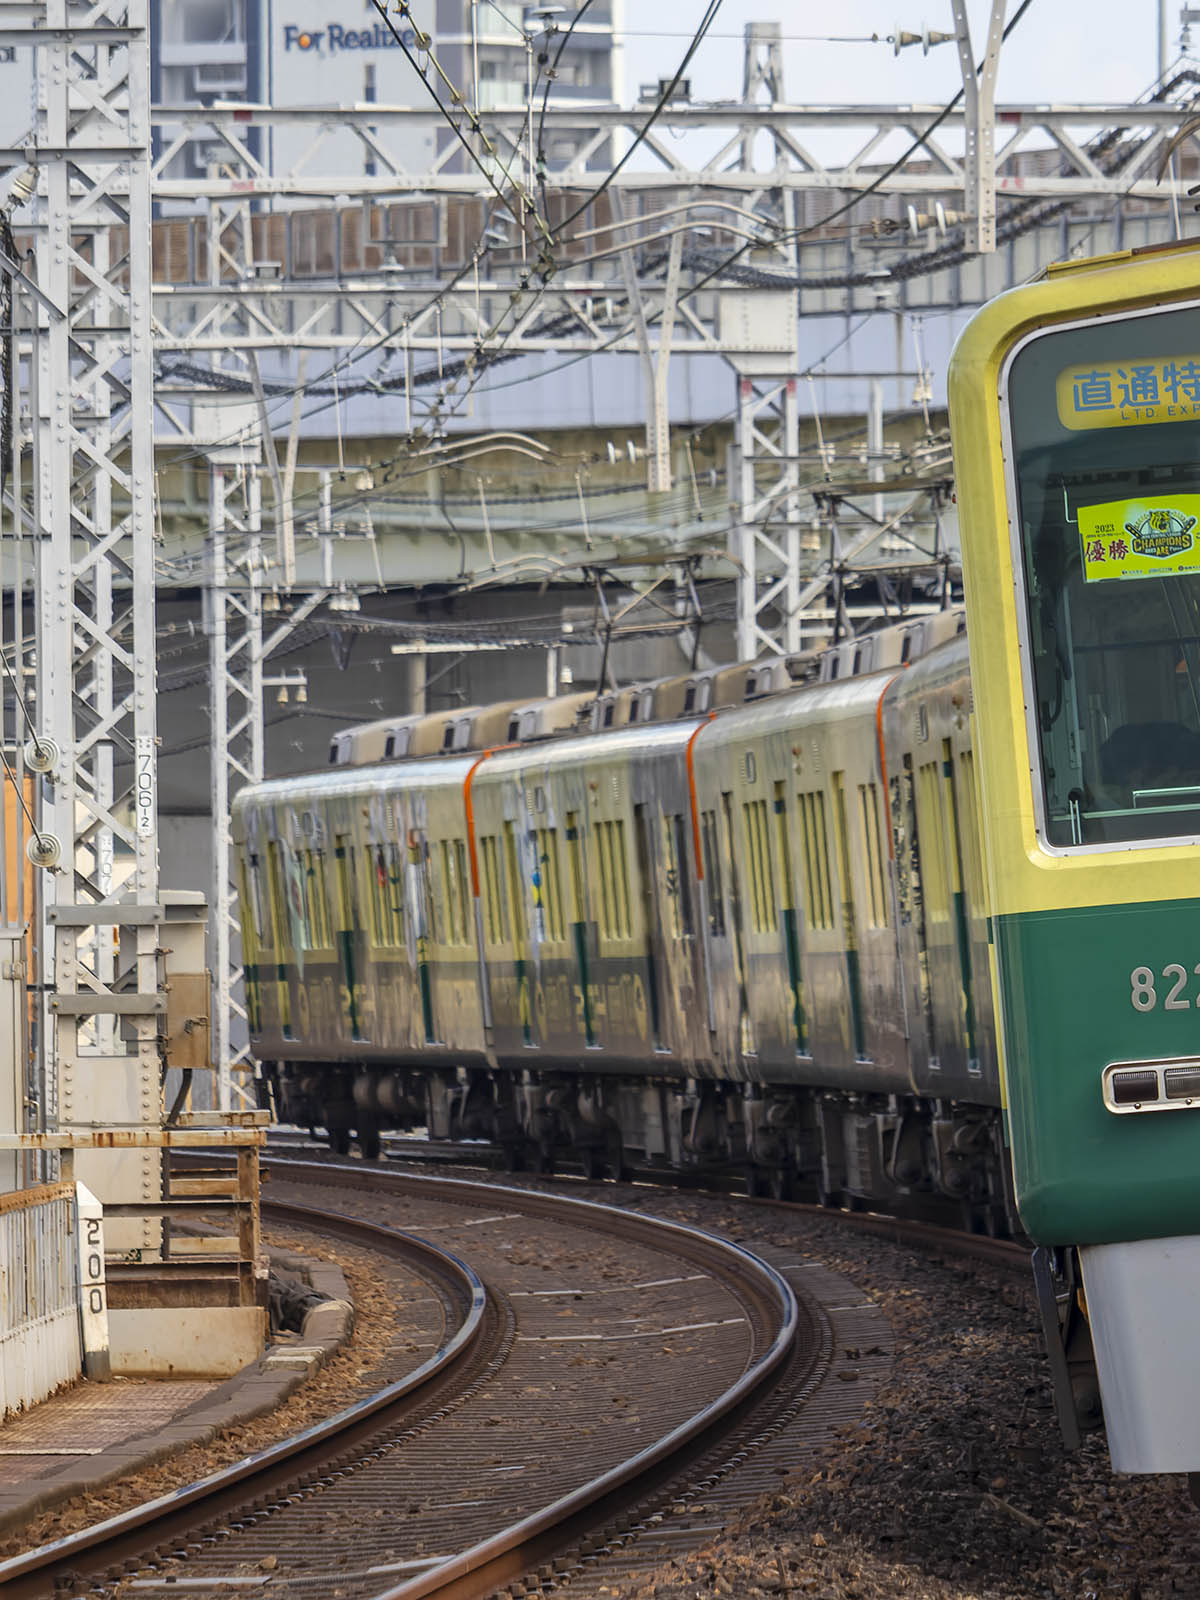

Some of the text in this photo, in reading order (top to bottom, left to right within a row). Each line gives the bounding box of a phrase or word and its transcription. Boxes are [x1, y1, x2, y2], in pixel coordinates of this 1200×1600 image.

[283, 25, 324, 52] For
[1084, 538, 1130, 563] 優勝
[1133, 535, 1190, 553] CHAMPIONS
[87, 1219, 103, 1314] 200
